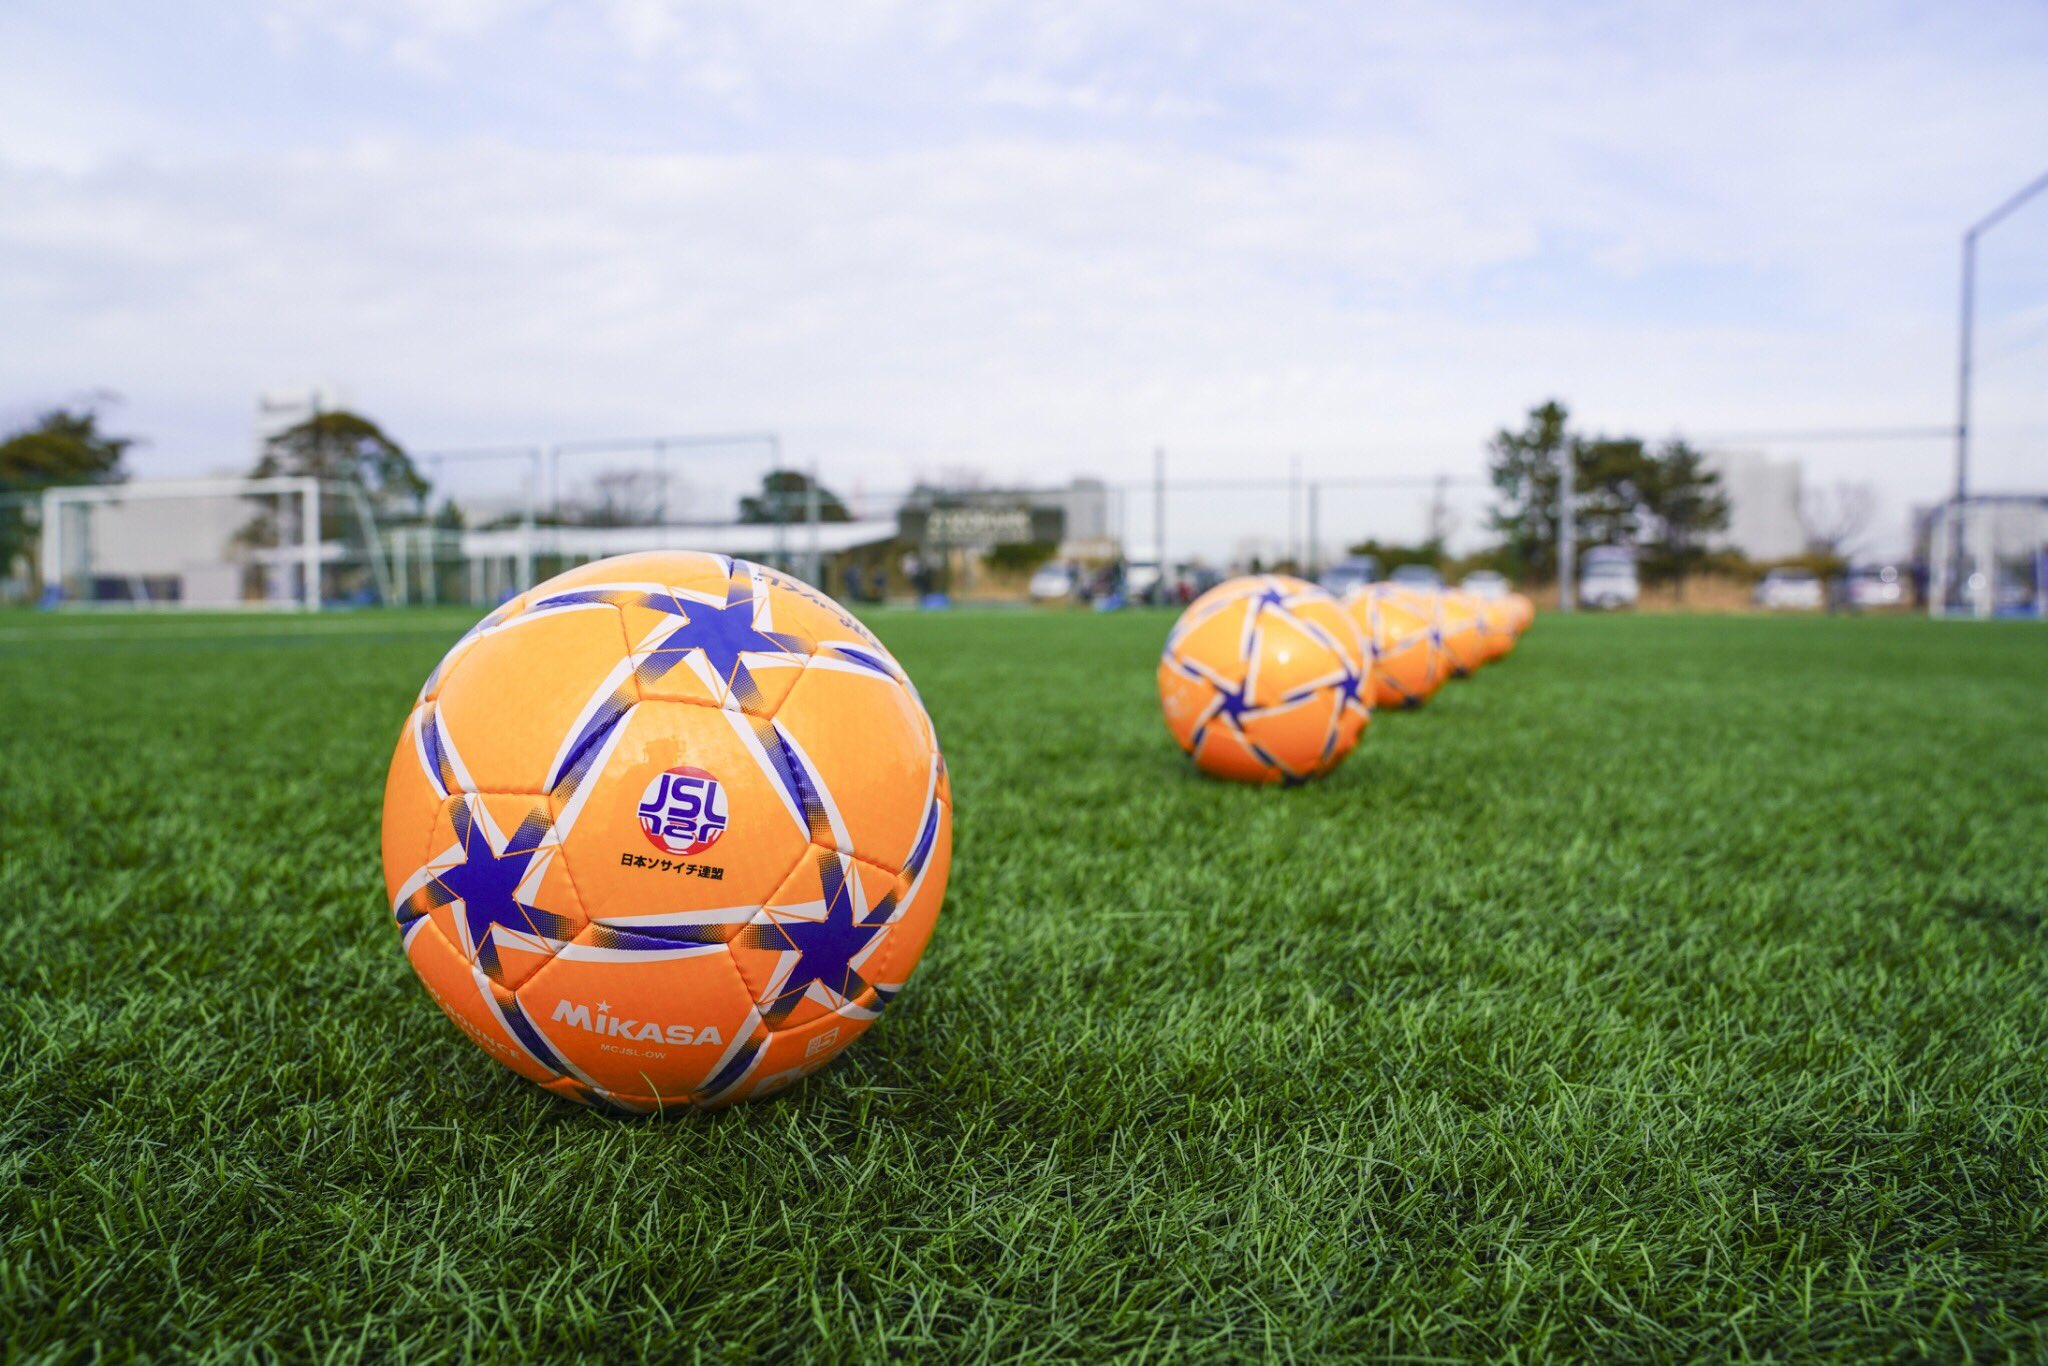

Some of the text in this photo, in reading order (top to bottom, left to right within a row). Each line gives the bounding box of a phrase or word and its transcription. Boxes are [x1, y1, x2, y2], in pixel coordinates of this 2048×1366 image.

[639, 774, 726, 824] JSL
[621, 853, 724, 880] 日本ソサイチ連盟
